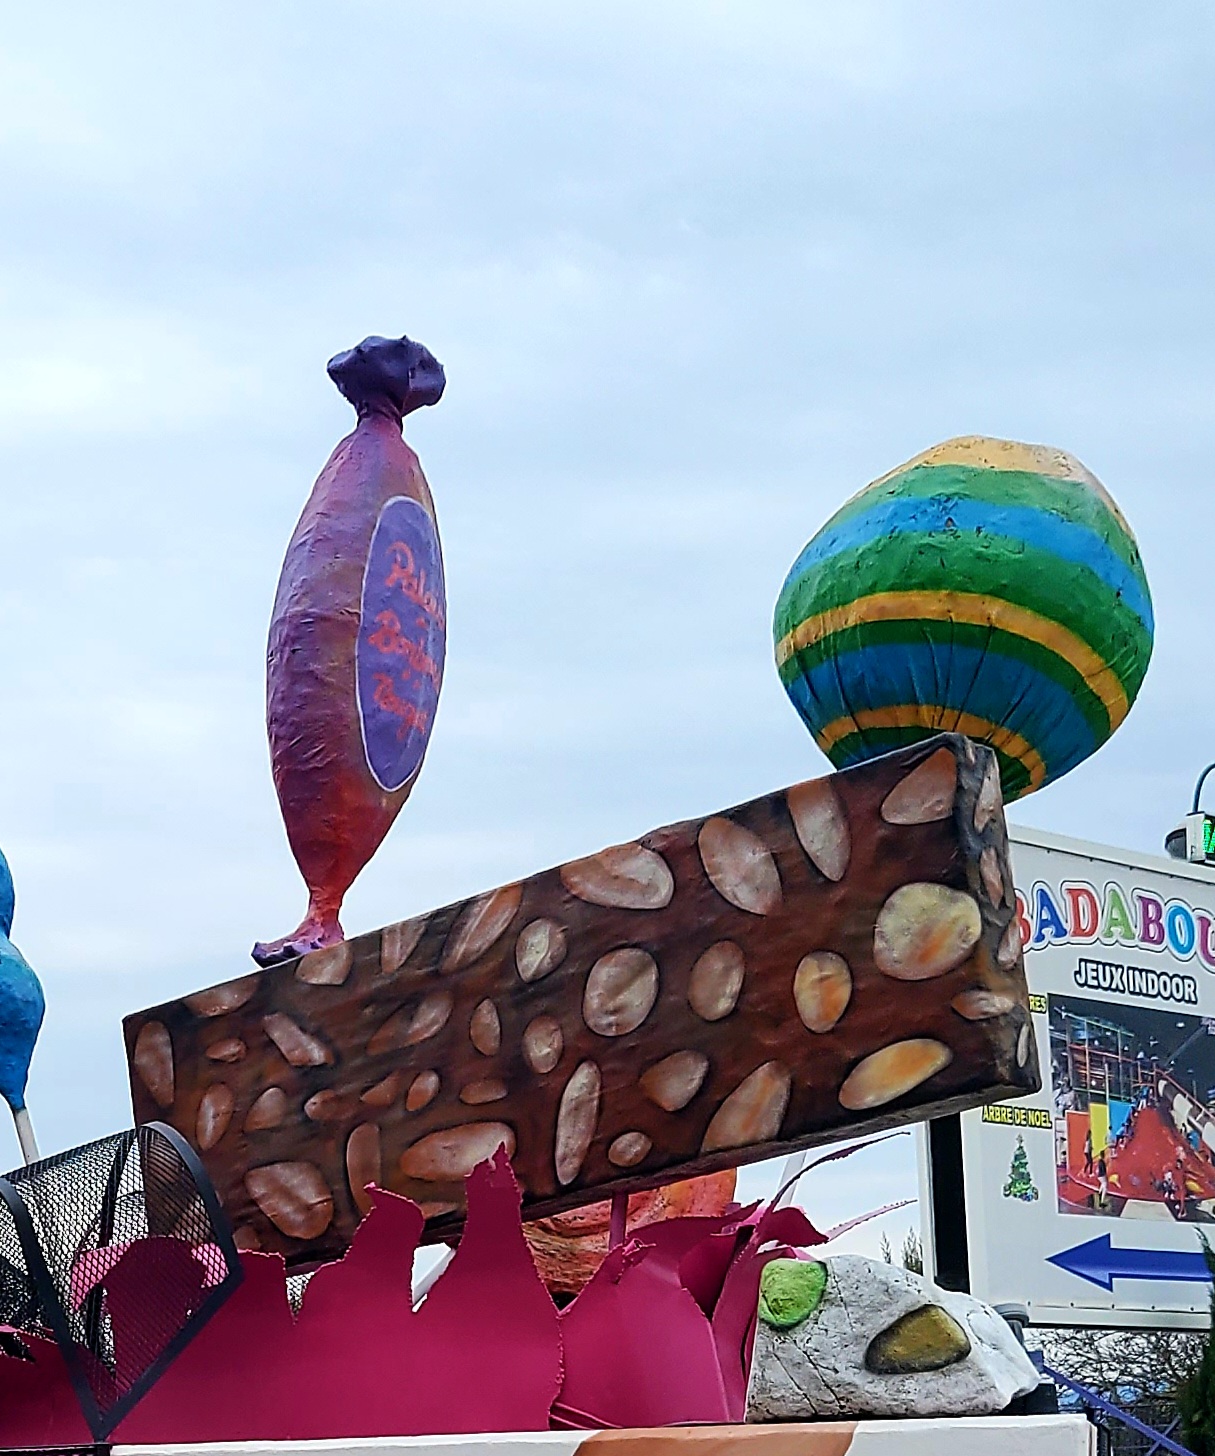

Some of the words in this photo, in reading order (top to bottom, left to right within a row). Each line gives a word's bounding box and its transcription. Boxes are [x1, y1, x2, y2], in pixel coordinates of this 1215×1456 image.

[1074, 959, 1125, 993] JEUX
[1127, 967, 1198, 1004] INDOOR
[983, 1104, 1013, 1124] ARBRE
[1014, 1107, 1027, 1126] DE
[1028, 1109, 1052, 1128] NOEL
